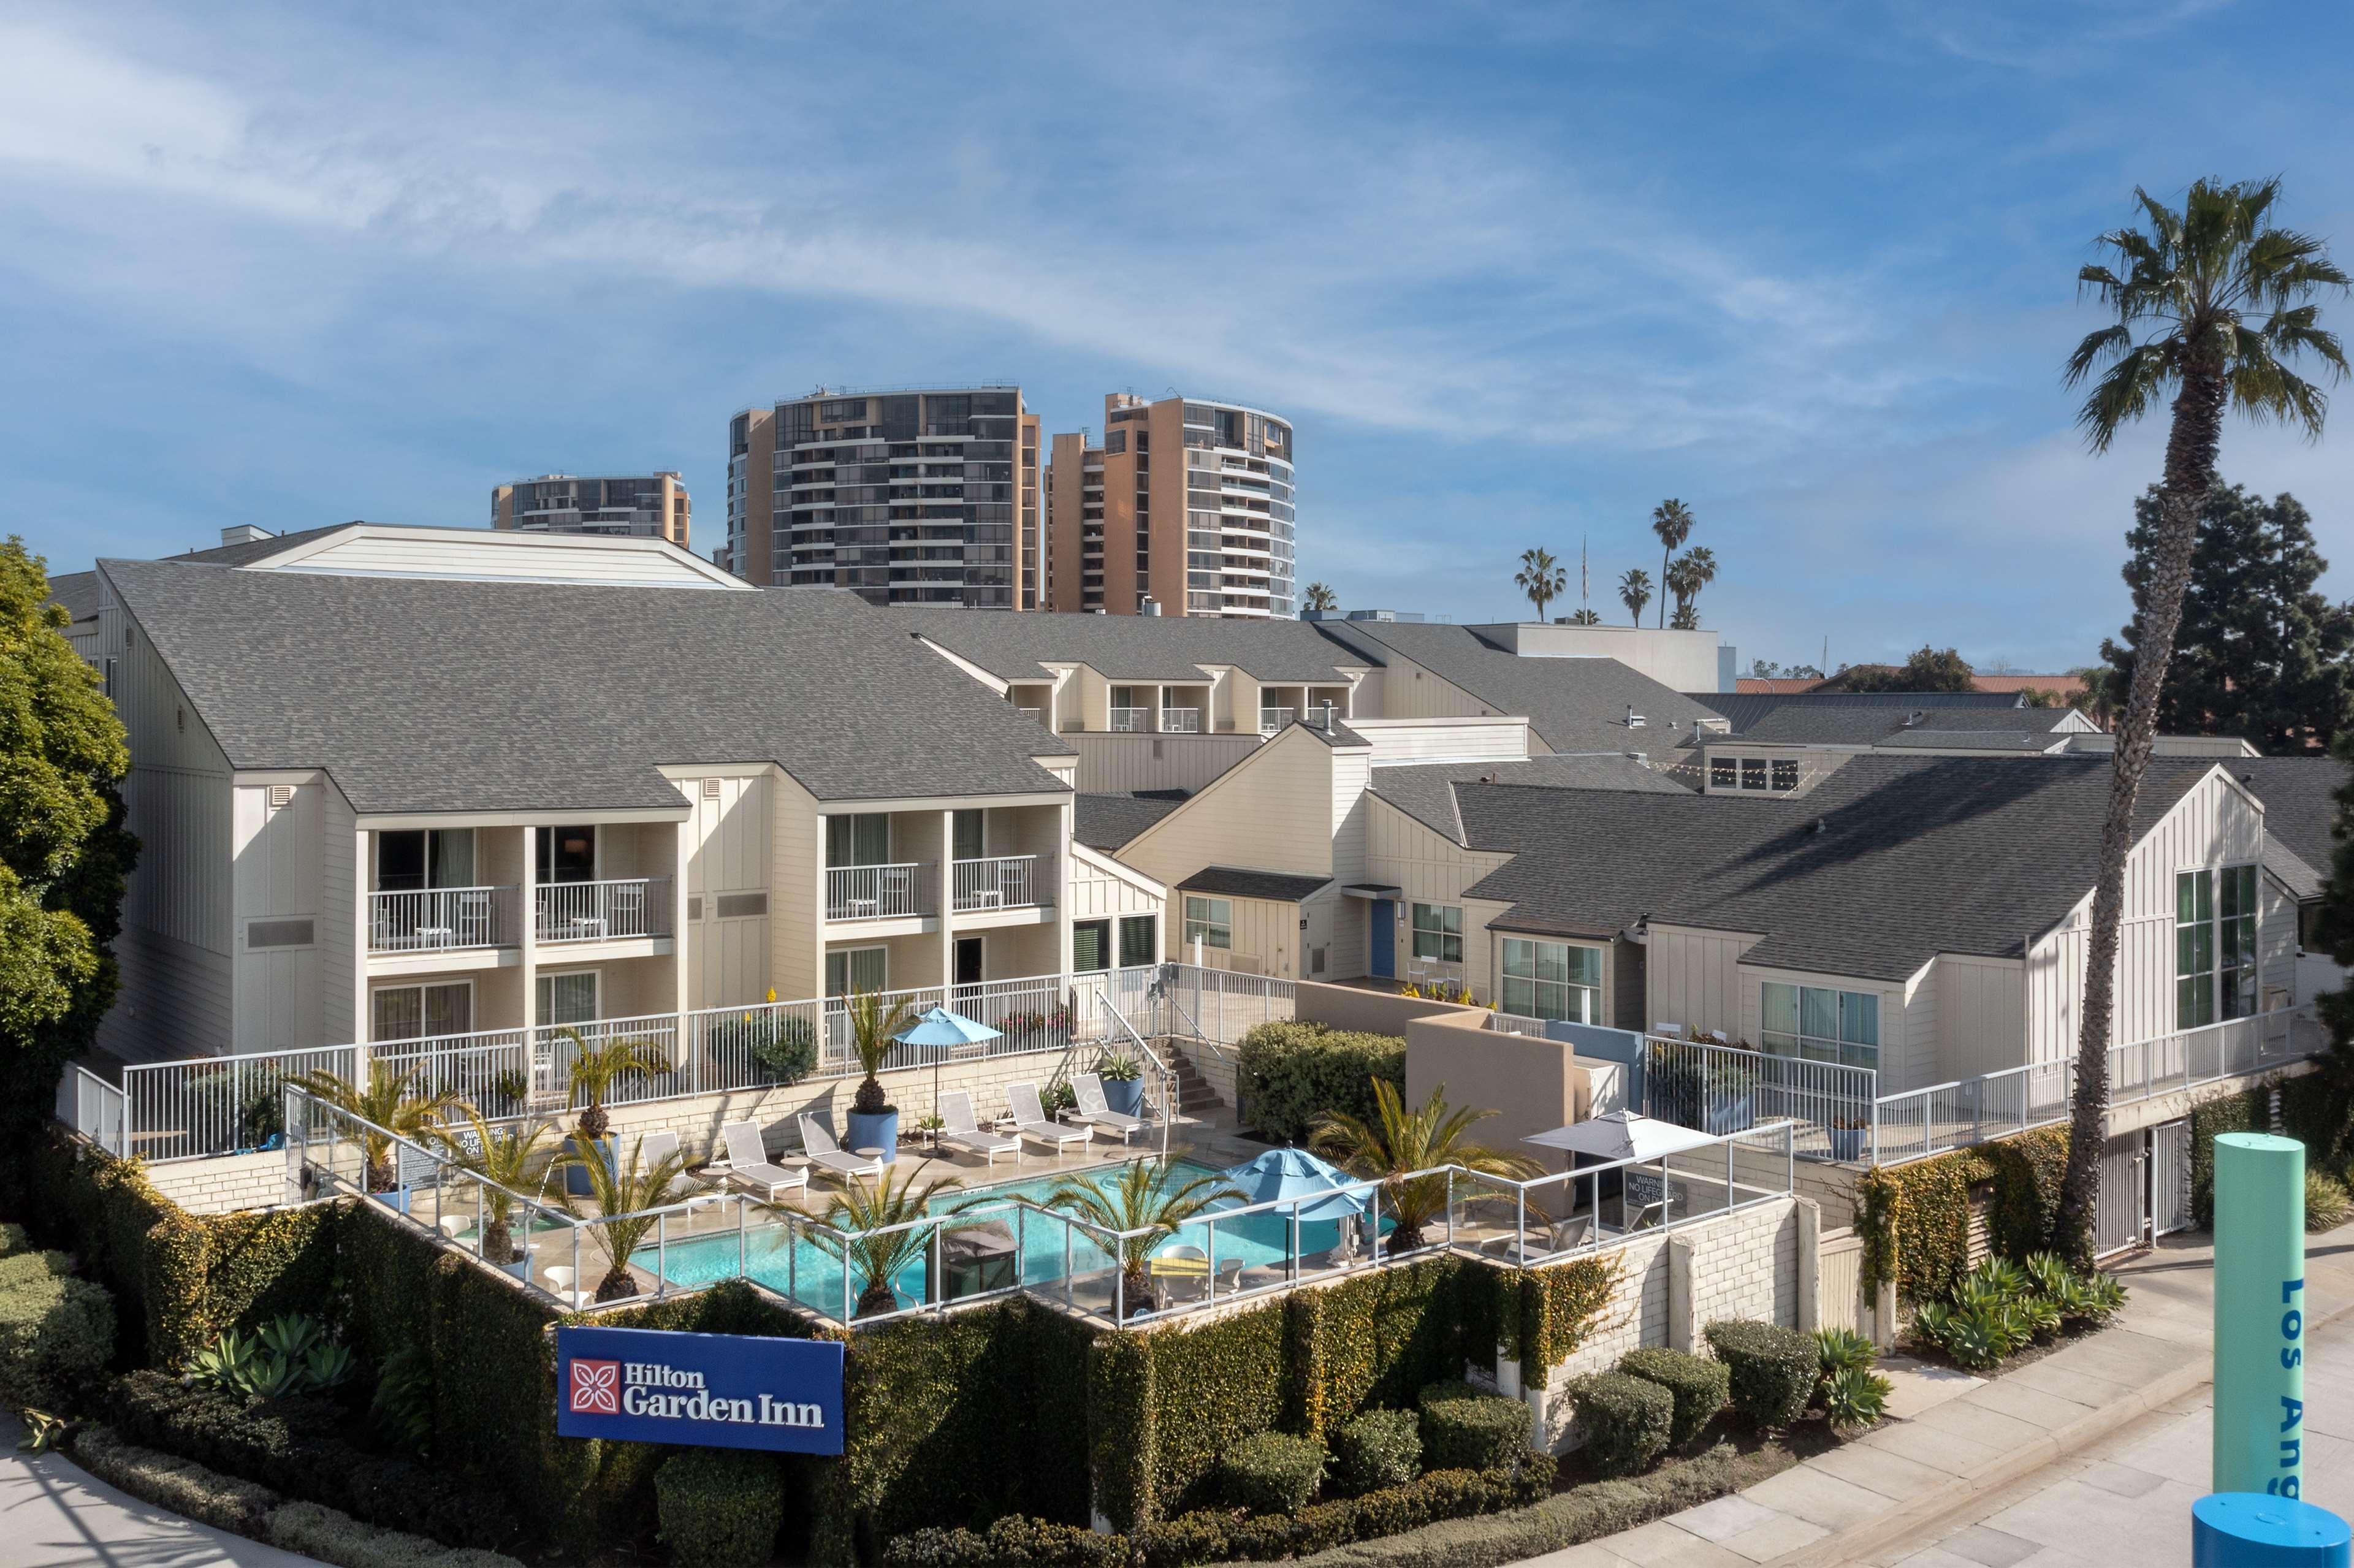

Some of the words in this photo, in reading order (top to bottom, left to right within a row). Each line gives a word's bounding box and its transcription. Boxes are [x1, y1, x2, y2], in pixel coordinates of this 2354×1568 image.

[463, 1127, 505, 1140] WAING:
[466, 1146, 479, 1155] ON
[1629, 1182, 1640, 1192] NO
[1642, 1186, 1683, 1201] LIFEGARD
[1636, 1175, 1674, 1191] WARNIG:
[1638, 1193, 1650, 1202] ON
[2281, 1279, 2303, 1369] Los
[624, 1363, 706, 1388] Hilton
[623, 1386, 756, 1423] Garden
[758, 1393, 825, 1428] Inn
